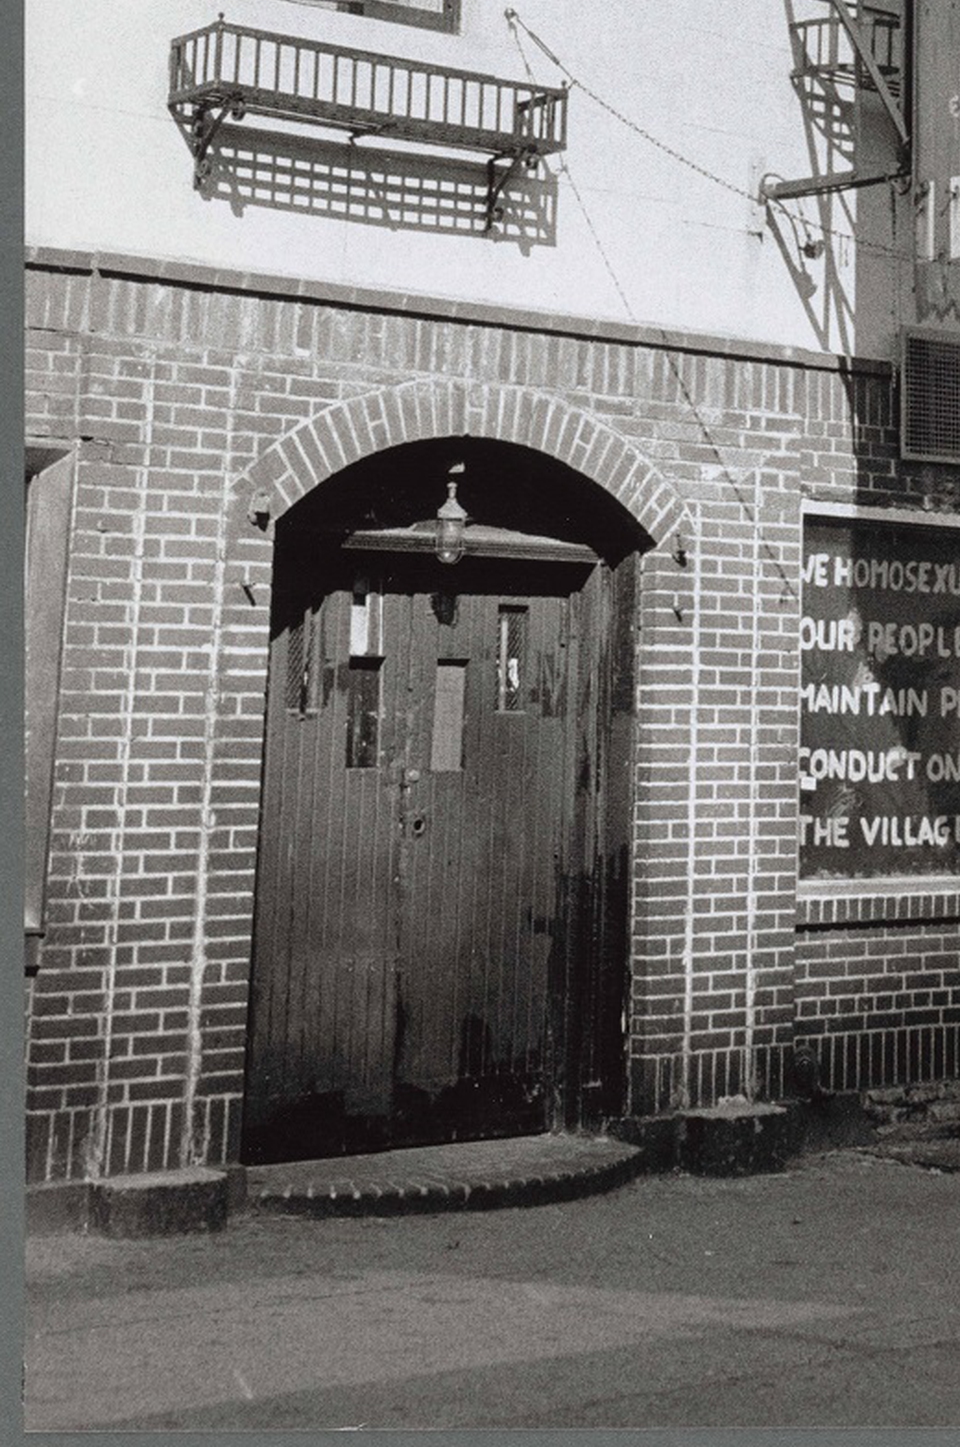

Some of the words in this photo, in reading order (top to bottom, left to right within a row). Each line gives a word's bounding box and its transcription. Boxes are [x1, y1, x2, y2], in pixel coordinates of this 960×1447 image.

[800, 615, 856, 653] OUR
[799, 682, 928, 718] MAINTAIN
[799, 746, 922, 783] CONDUCT
[800, 814, 850, 848] THE
